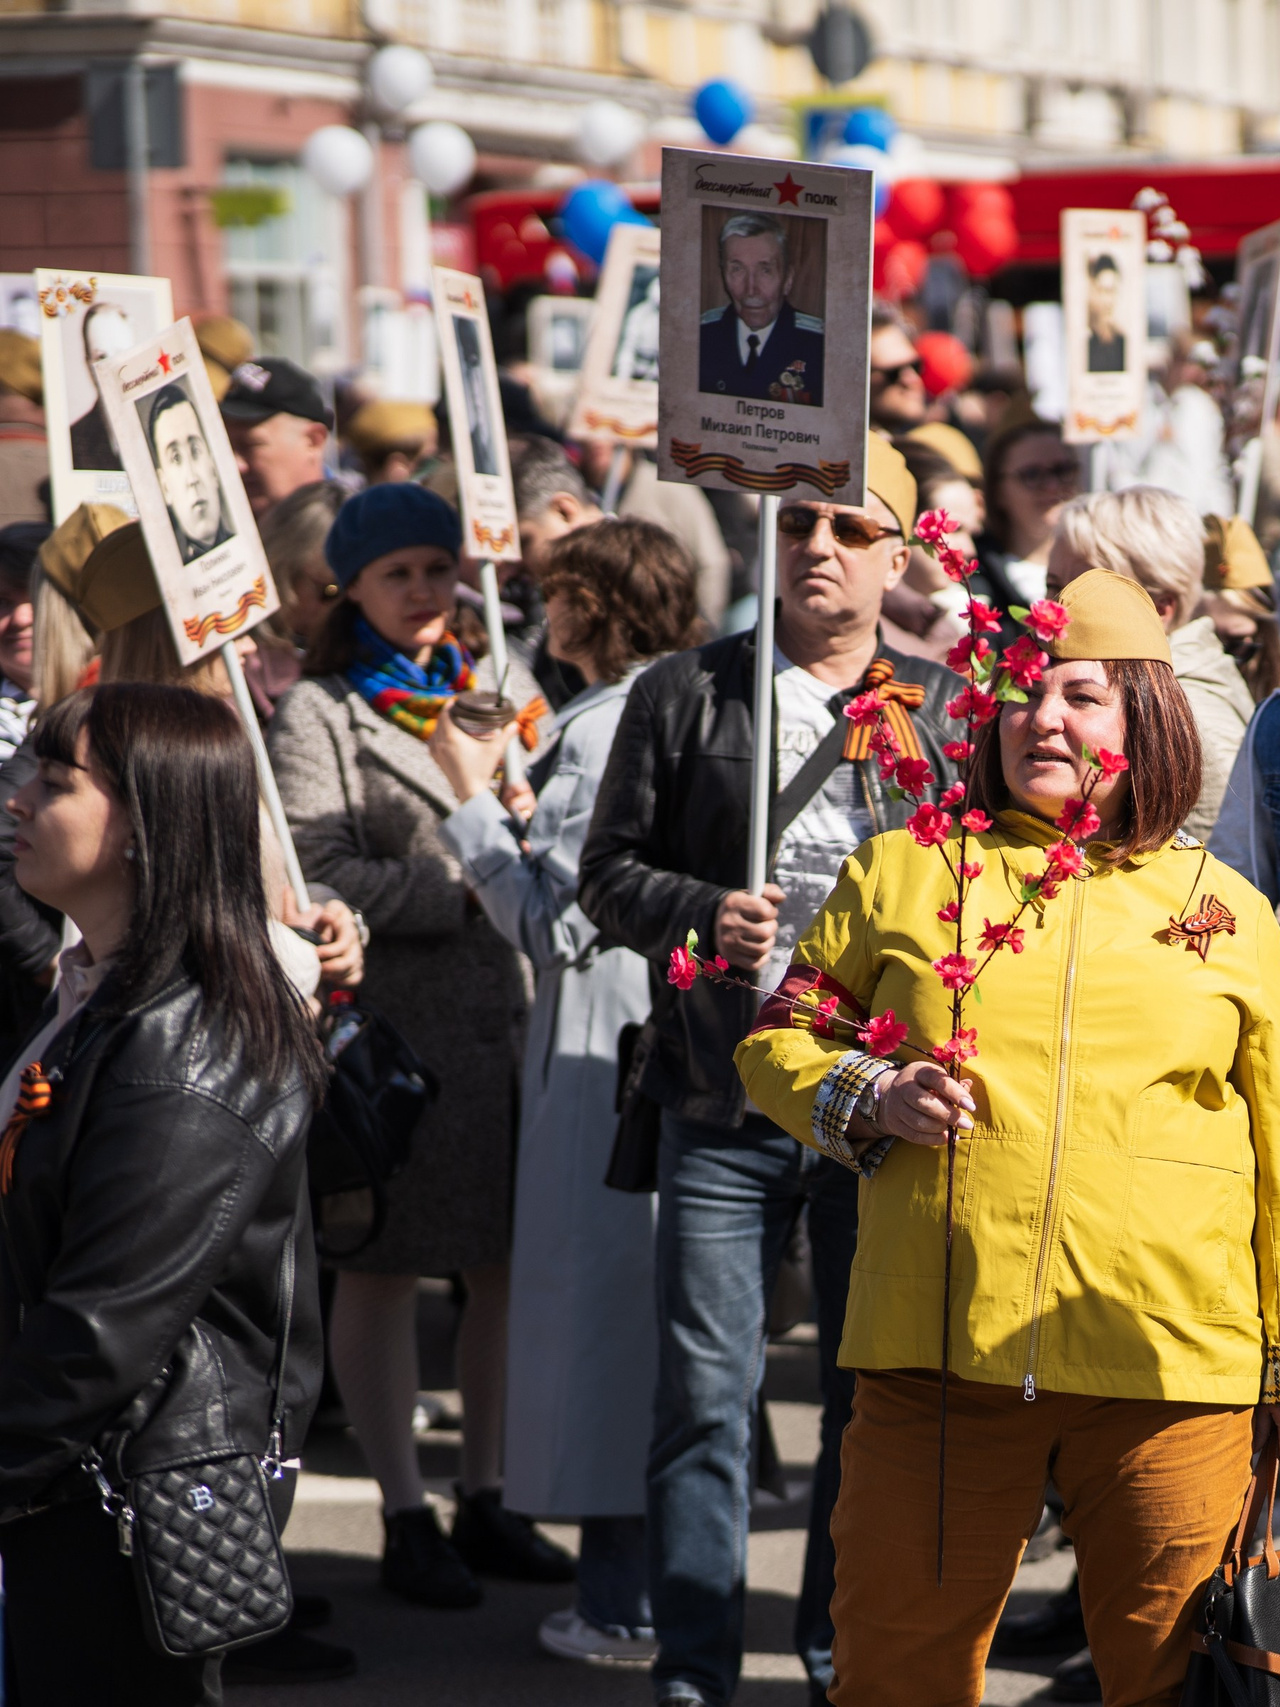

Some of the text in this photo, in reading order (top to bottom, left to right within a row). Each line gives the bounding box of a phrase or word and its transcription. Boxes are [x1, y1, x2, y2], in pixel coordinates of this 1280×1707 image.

[694, 163, 774, 199] бессмертный
[736, 400, 785, 420] Петров
[701, 416, 820, 445] Михаил Петрович
